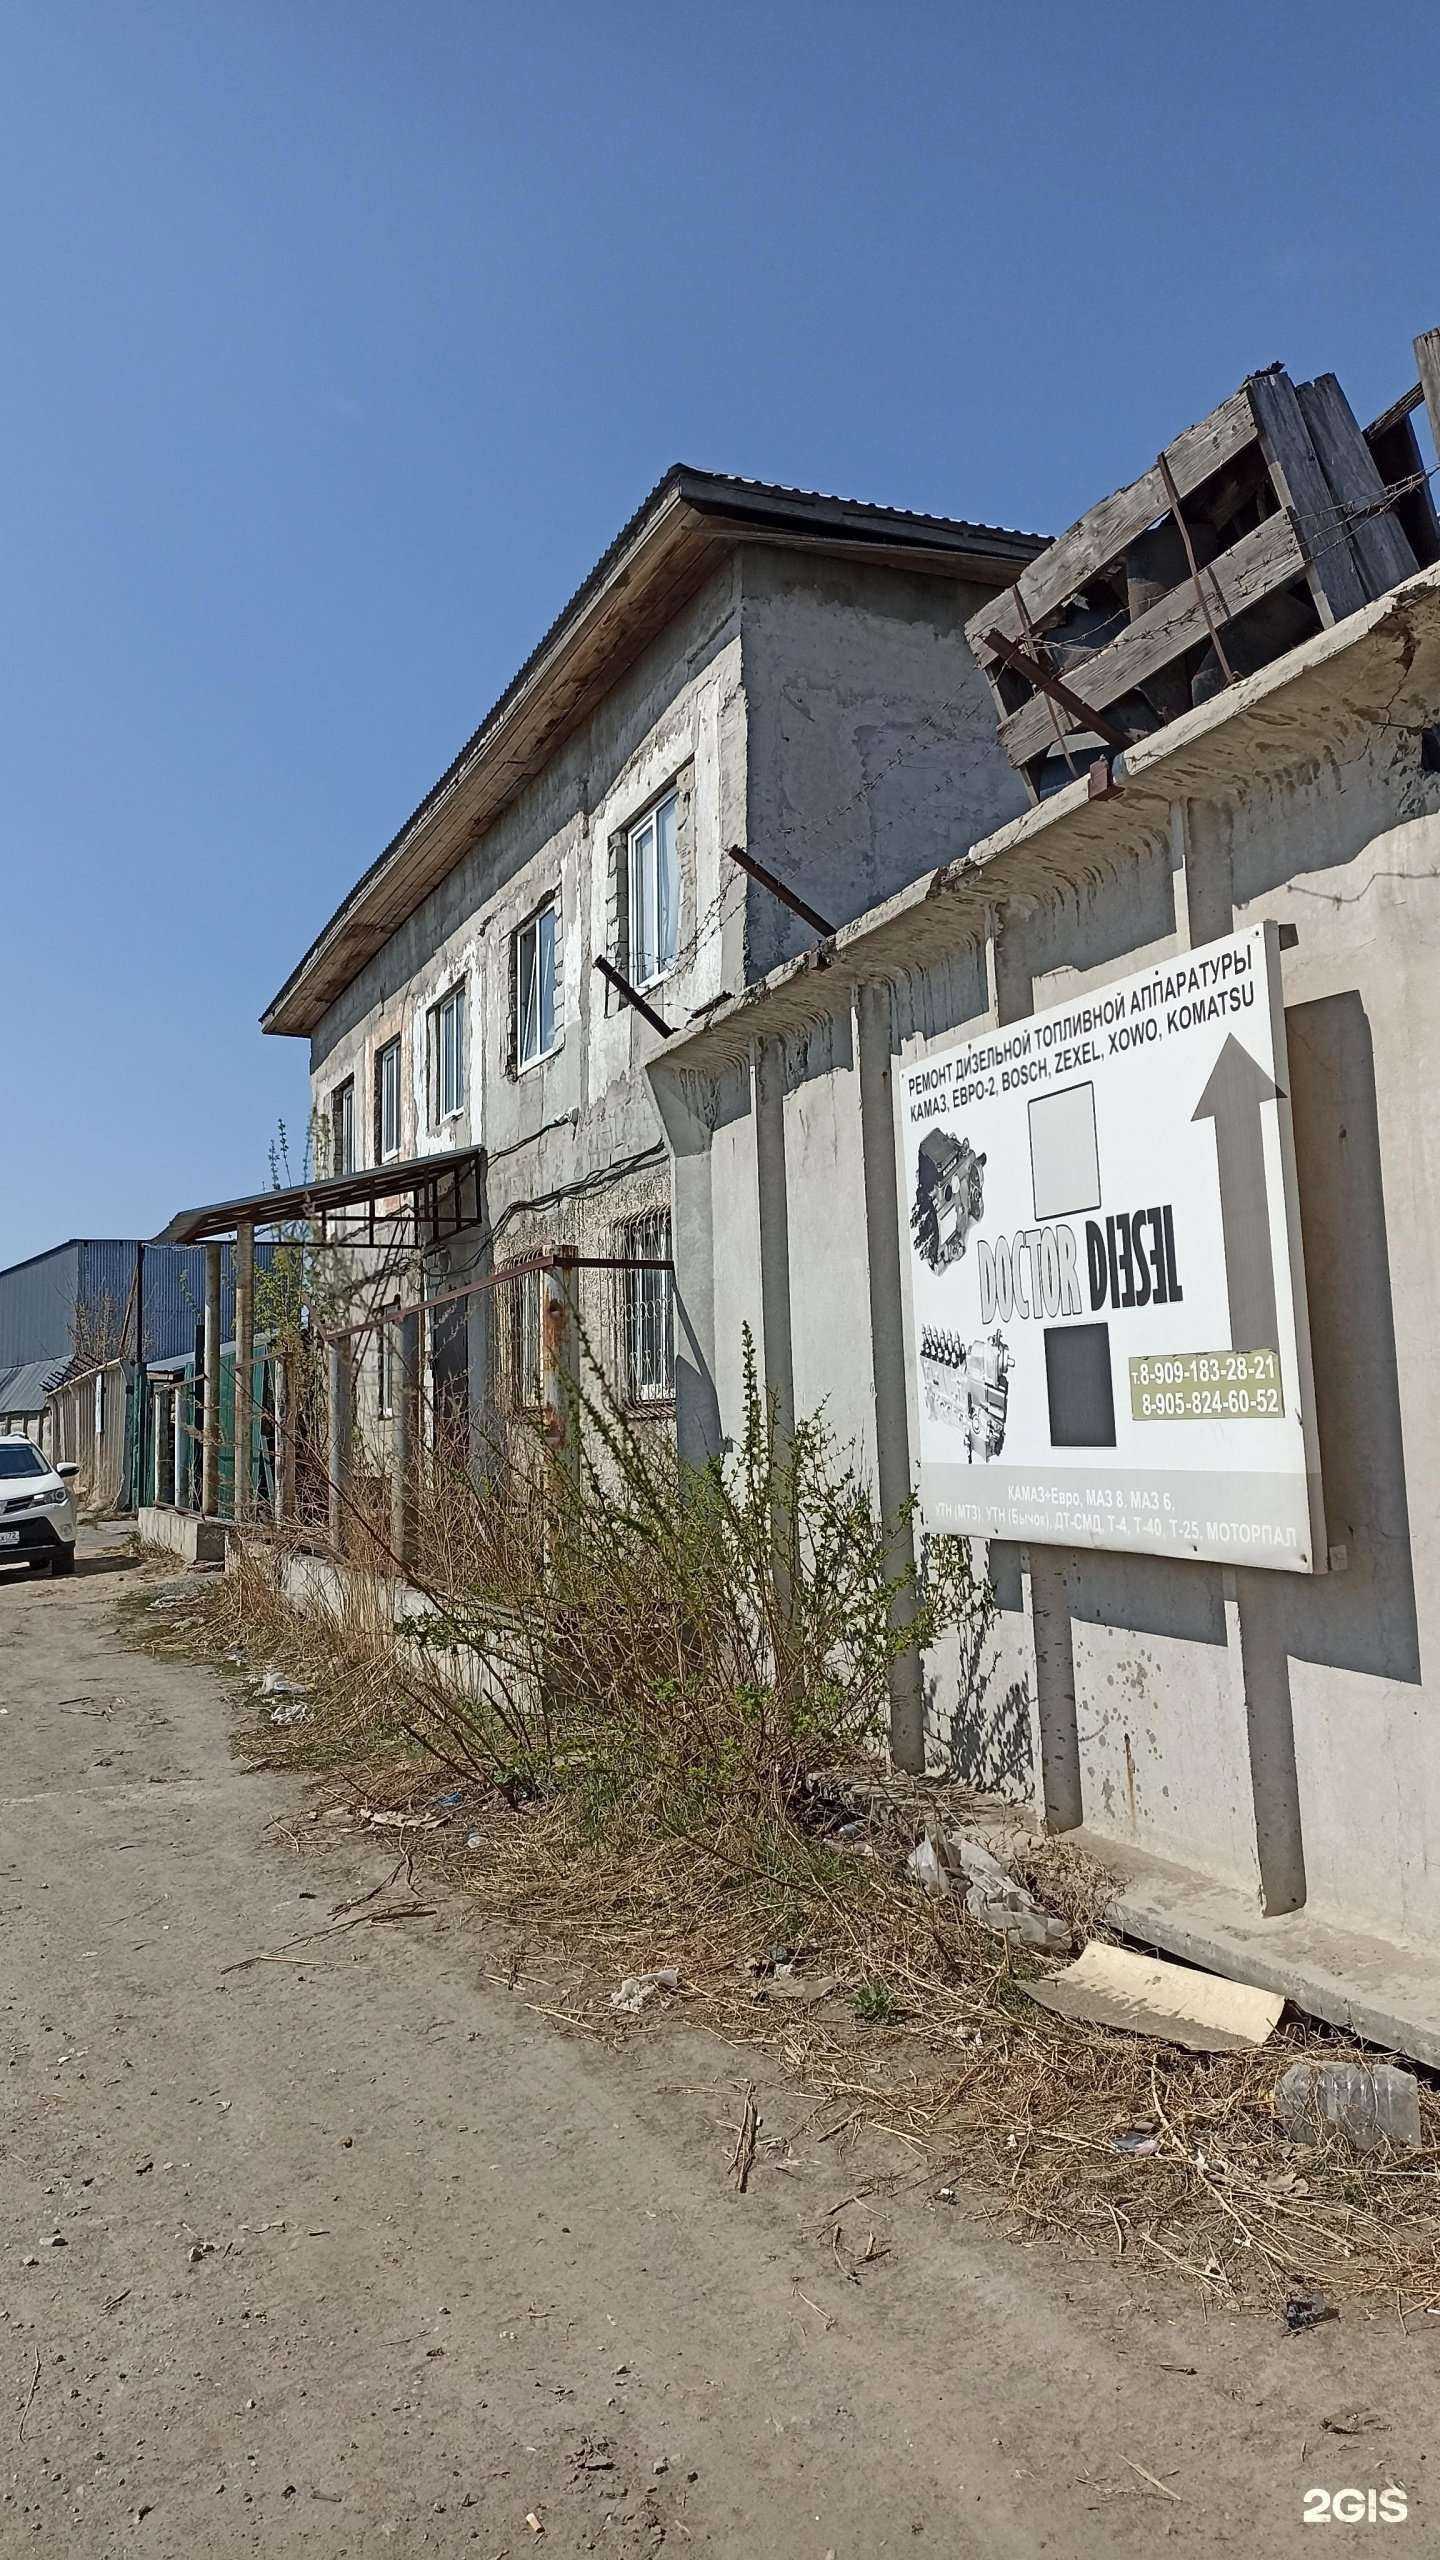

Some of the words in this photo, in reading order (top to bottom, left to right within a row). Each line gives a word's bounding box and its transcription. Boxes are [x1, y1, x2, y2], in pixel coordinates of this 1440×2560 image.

[908, 1062, 953, 1097] РЕМОНТ
[956, 1029, 1032, 1084] ДИЗЕЛЬНОЙ
[1035, 992, 1126, 1050] ТОПЛИВНОЙ
[1131, 944, 1252, 1015] АППАРАТУРЫ
[910, 1094, 950, 1123] КАМАЗ,
[952, 1076, 999, 1109] ЕВРО-2,
[1002, 1057, 1052, 1091] BOSCH,
[1055, 1040, 1105, 1074] ZEXEL,
[1108, 1018, 1162, 1055] XOWO,
[1167, 981, 1255, 1034] KOMATSU
[977, 1224, 1082, 1325] DOCTOR
[1142, 1389, 1279, 1415] 8-905-824-60-52
[935, 1502, 952, 1517] УТН
[986, 1506, 1005, 1520] УТН
[1206, 1521, 1297, 1547] МОТОРПАЛ
[1086, 1489, 1113, 1508] МАЗ
[1130, 1491, 1160, 1511] МАЗ
